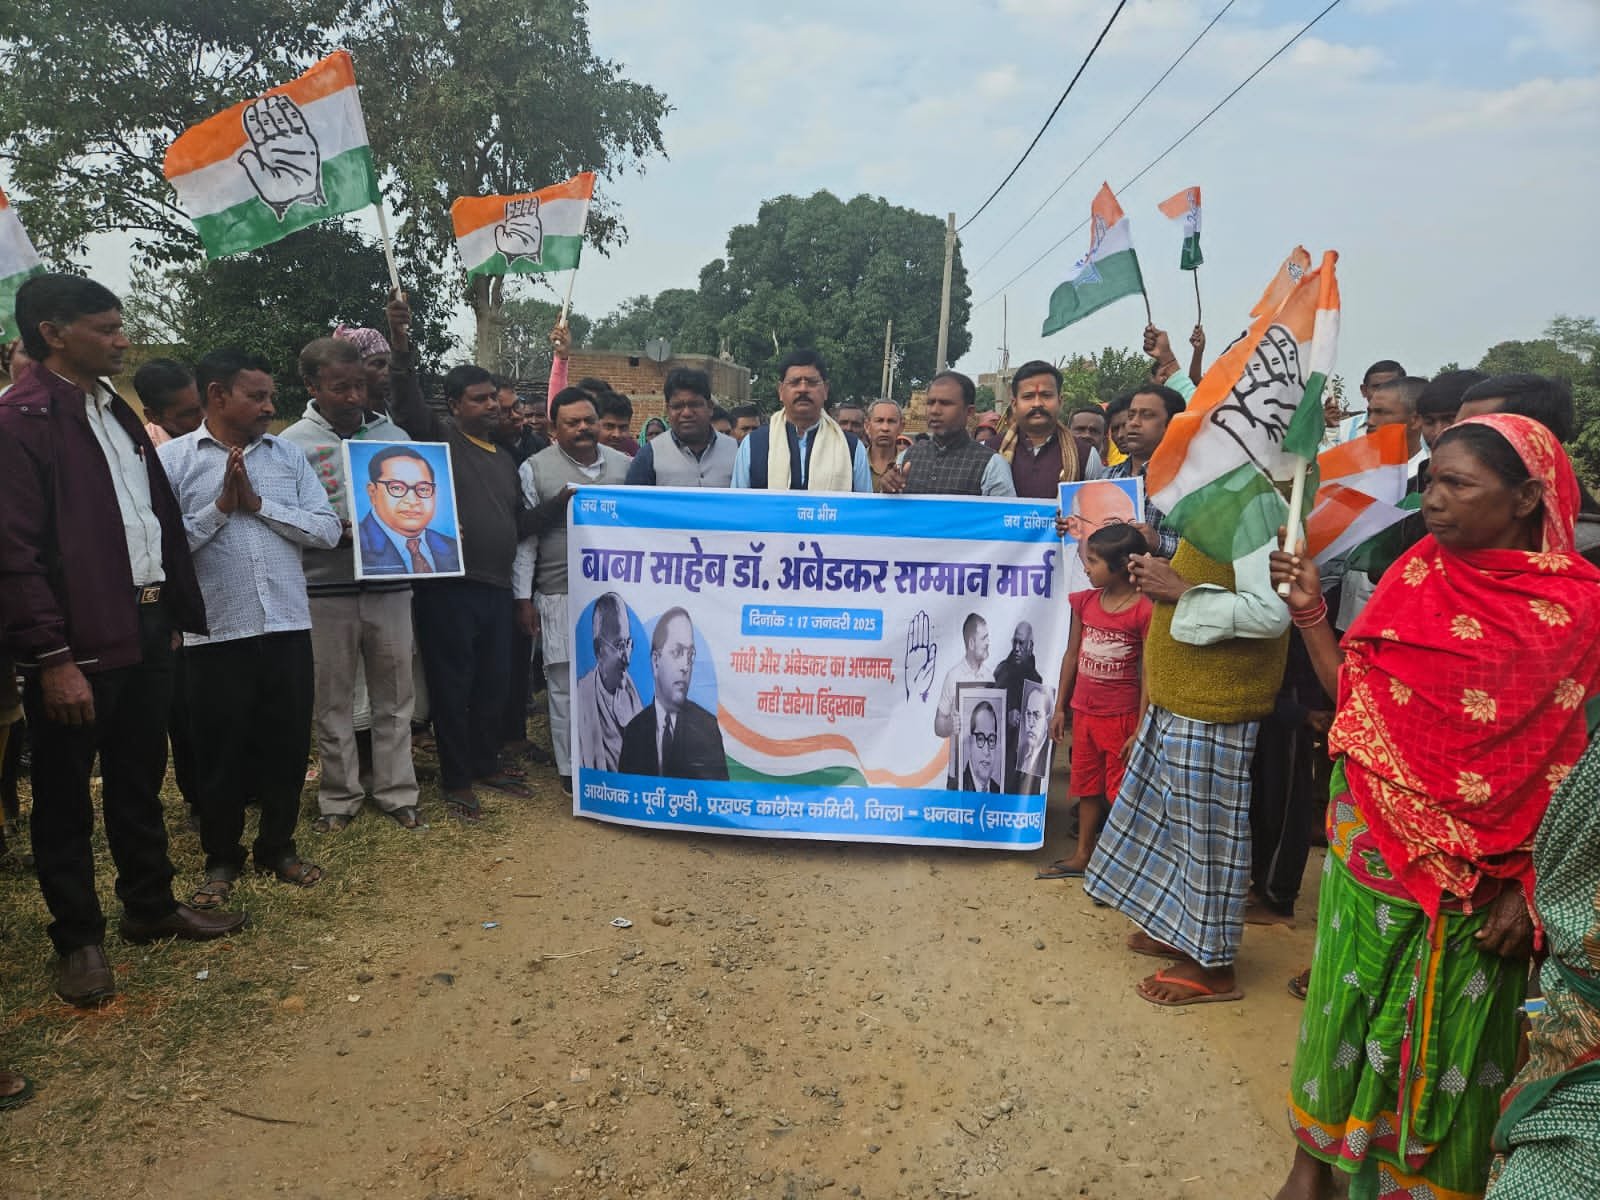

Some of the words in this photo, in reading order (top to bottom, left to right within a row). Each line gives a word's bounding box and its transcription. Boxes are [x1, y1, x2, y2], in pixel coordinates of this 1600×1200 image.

[581, 499, 598, 513] जय
[797, 507, 814, 521] जय
[817, 503, 838, 521] भीम
[1003, 514, 1020, 528] जय
[581, 548, 645, 583] बाबा
[649, 537, 728, 592] साहेब
[732, 541, 769, 591] डॉ.
[777, 541, 888, 593] अंबेडकर
[894, 561, 991, 598] सम्मान
[996, 550, 1056, 599] मार्च
[749, 608, 785, 627] दिनांक
[798, 616, 807, 629] 17
[811, 612, 850, 630] जनवरी
[853, 618, 876, 631] 2025
[730, 645, 758, 673] गांधी
[758, 648, 781, 674] और
[783, 648, 829, 678] अंबेडकर
[830, 655, 846, 677] का
[848, 657, 896, 684] अपमान,
[757, 685, 783, 714] नहीं
[783, 687, 815, 715] सहेगा
[816, 685, 866, 722] हिंदुस्तान
[584, 782, 630, 805] आयोजक
[642, 786, 667, 816] पूर्वी
[707, 797, 753, 817] प्रखण्ड
[756, 794, 803, 820] कांग्रेस
[807, 797, 859, 821] कमिटी,
[864, 797, 905, 822] जिला
[923, 806, 976, 825] धनबाद
